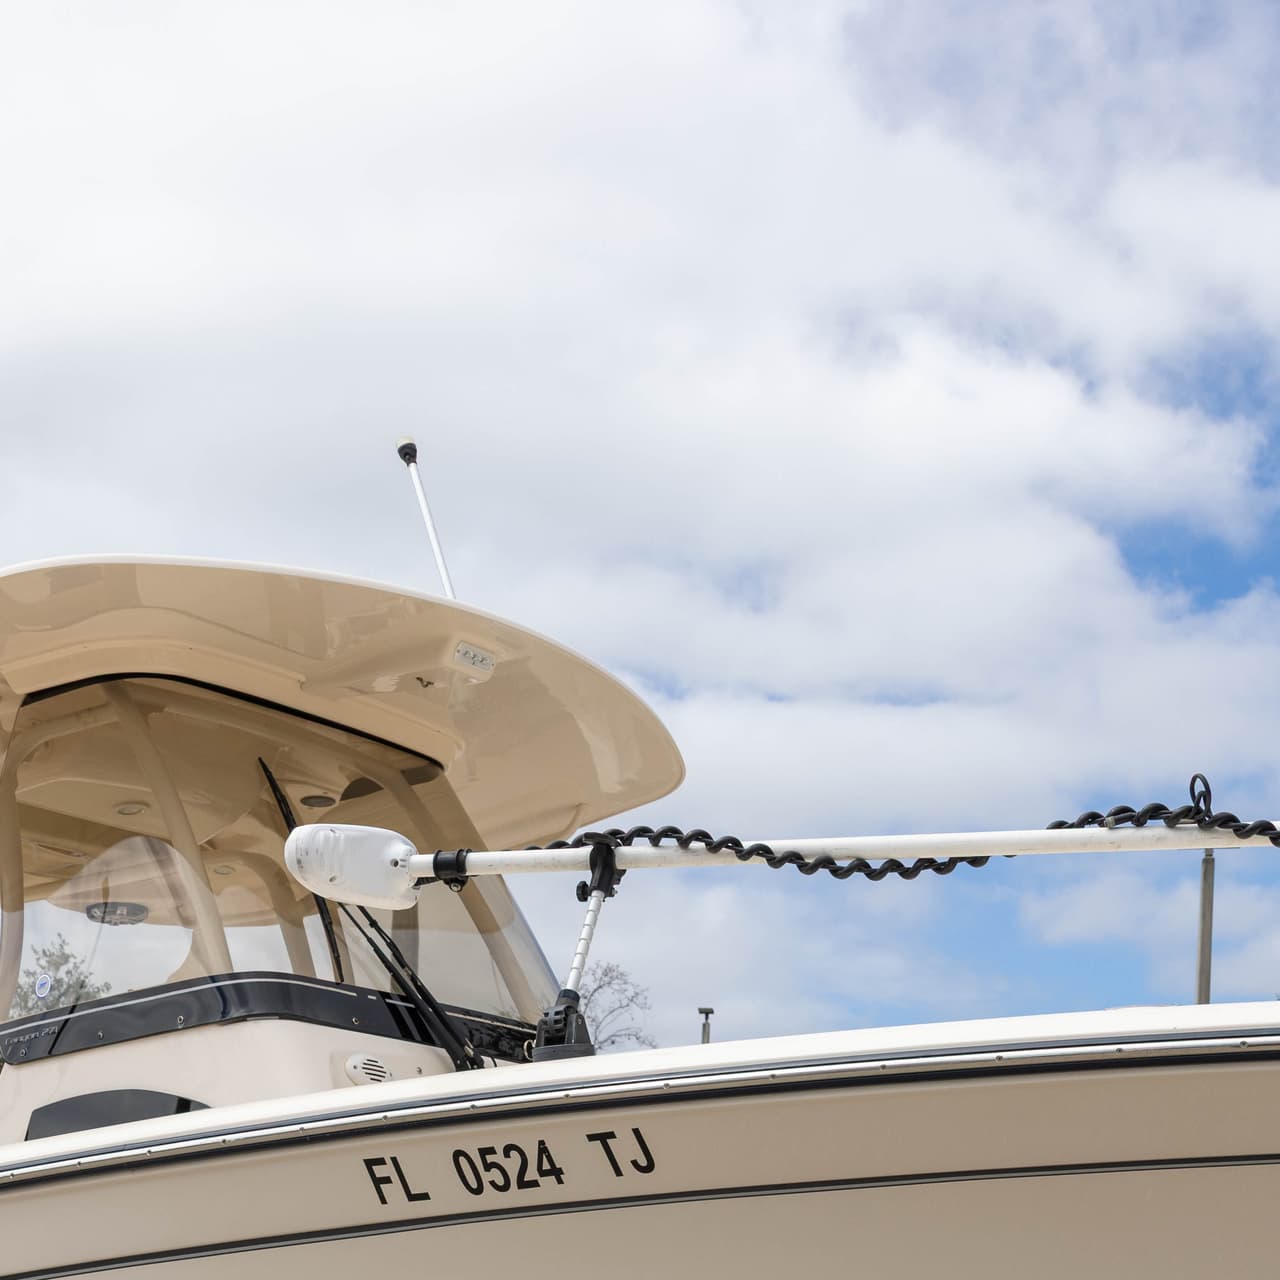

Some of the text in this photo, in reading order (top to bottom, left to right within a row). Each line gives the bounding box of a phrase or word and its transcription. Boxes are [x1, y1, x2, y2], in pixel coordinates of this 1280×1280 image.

[363, 1127, 656, 1205] FL 0524 TJ
